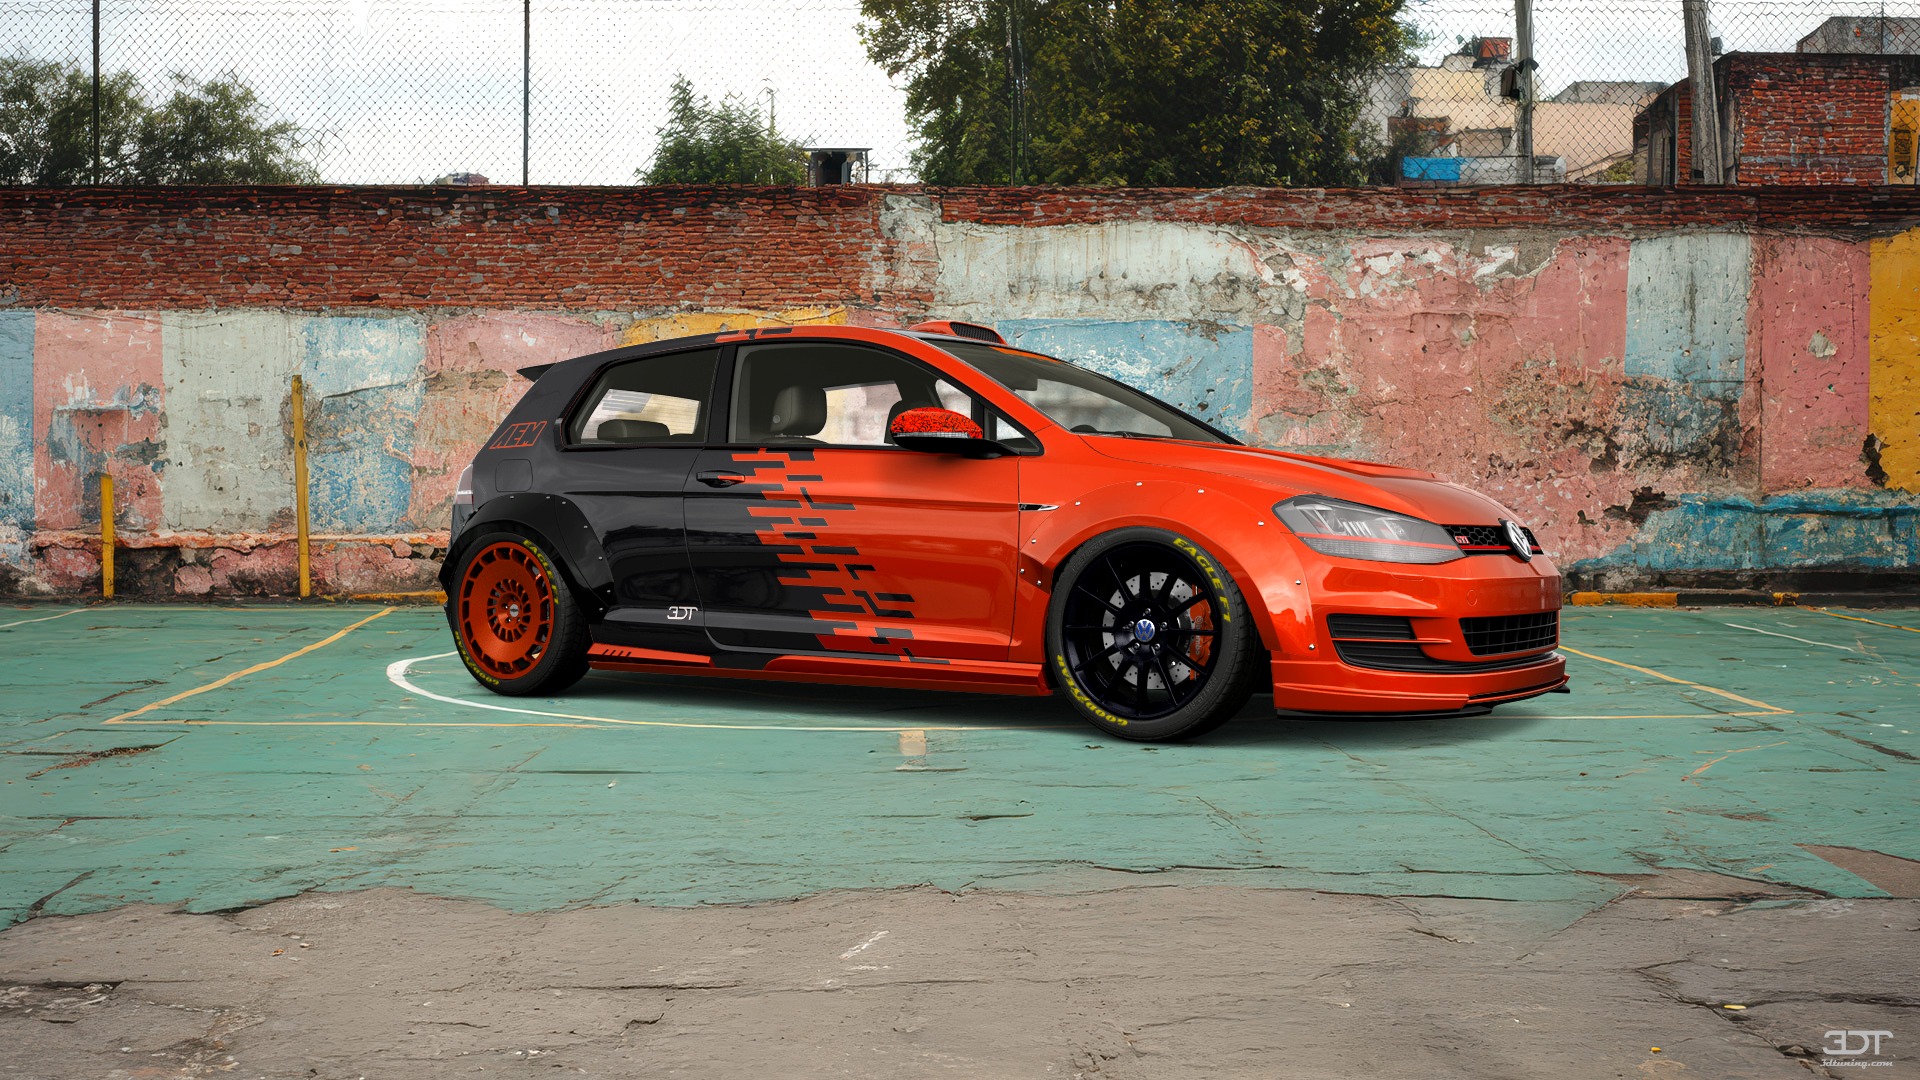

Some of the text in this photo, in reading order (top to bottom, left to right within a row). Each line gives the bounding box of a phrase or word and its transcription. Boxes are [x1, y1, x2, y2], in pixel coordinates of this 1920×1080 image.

[489, 421, 548, 450] AEM
[523, 540, 554, 579] EAGLE
[1455, 536, 1470, 545] GTI
[1173, 538, 1231, 622] EAGLE F1
[667, 606, 698, 620] 3DT
[455, 630, 499, 685] GOODYEAR
[1057, 655, 1128, 726] GOODYEAR
